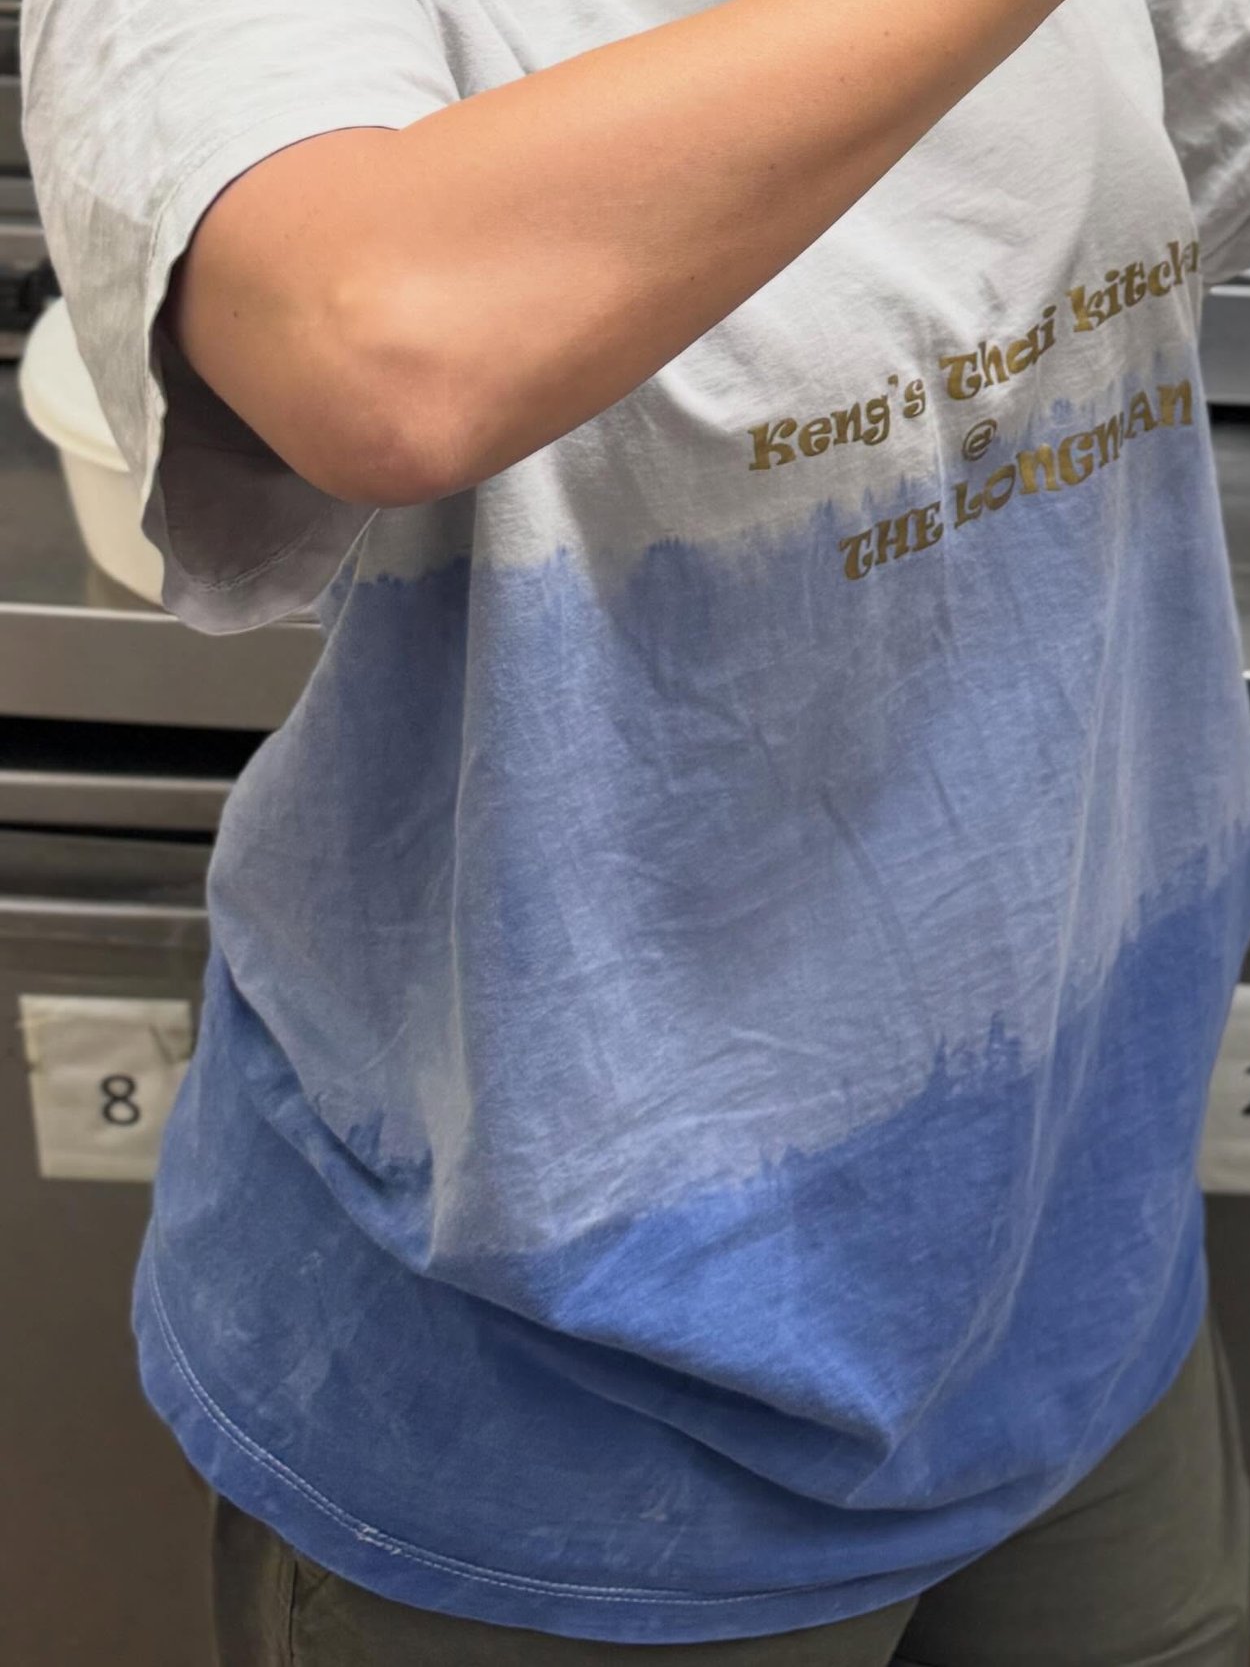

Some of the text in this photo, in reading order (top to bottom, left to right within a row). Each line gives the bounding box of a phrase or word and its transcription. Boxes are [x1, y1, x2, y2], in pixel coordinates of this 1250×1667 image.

[748, 373, 927, 471] Keng's
[938, 305, 1057, 401] Thai
[961, 418, 998, 462] @
[838, 500, 945, 581] THE
[100, 1073, 141, 1127] 8
